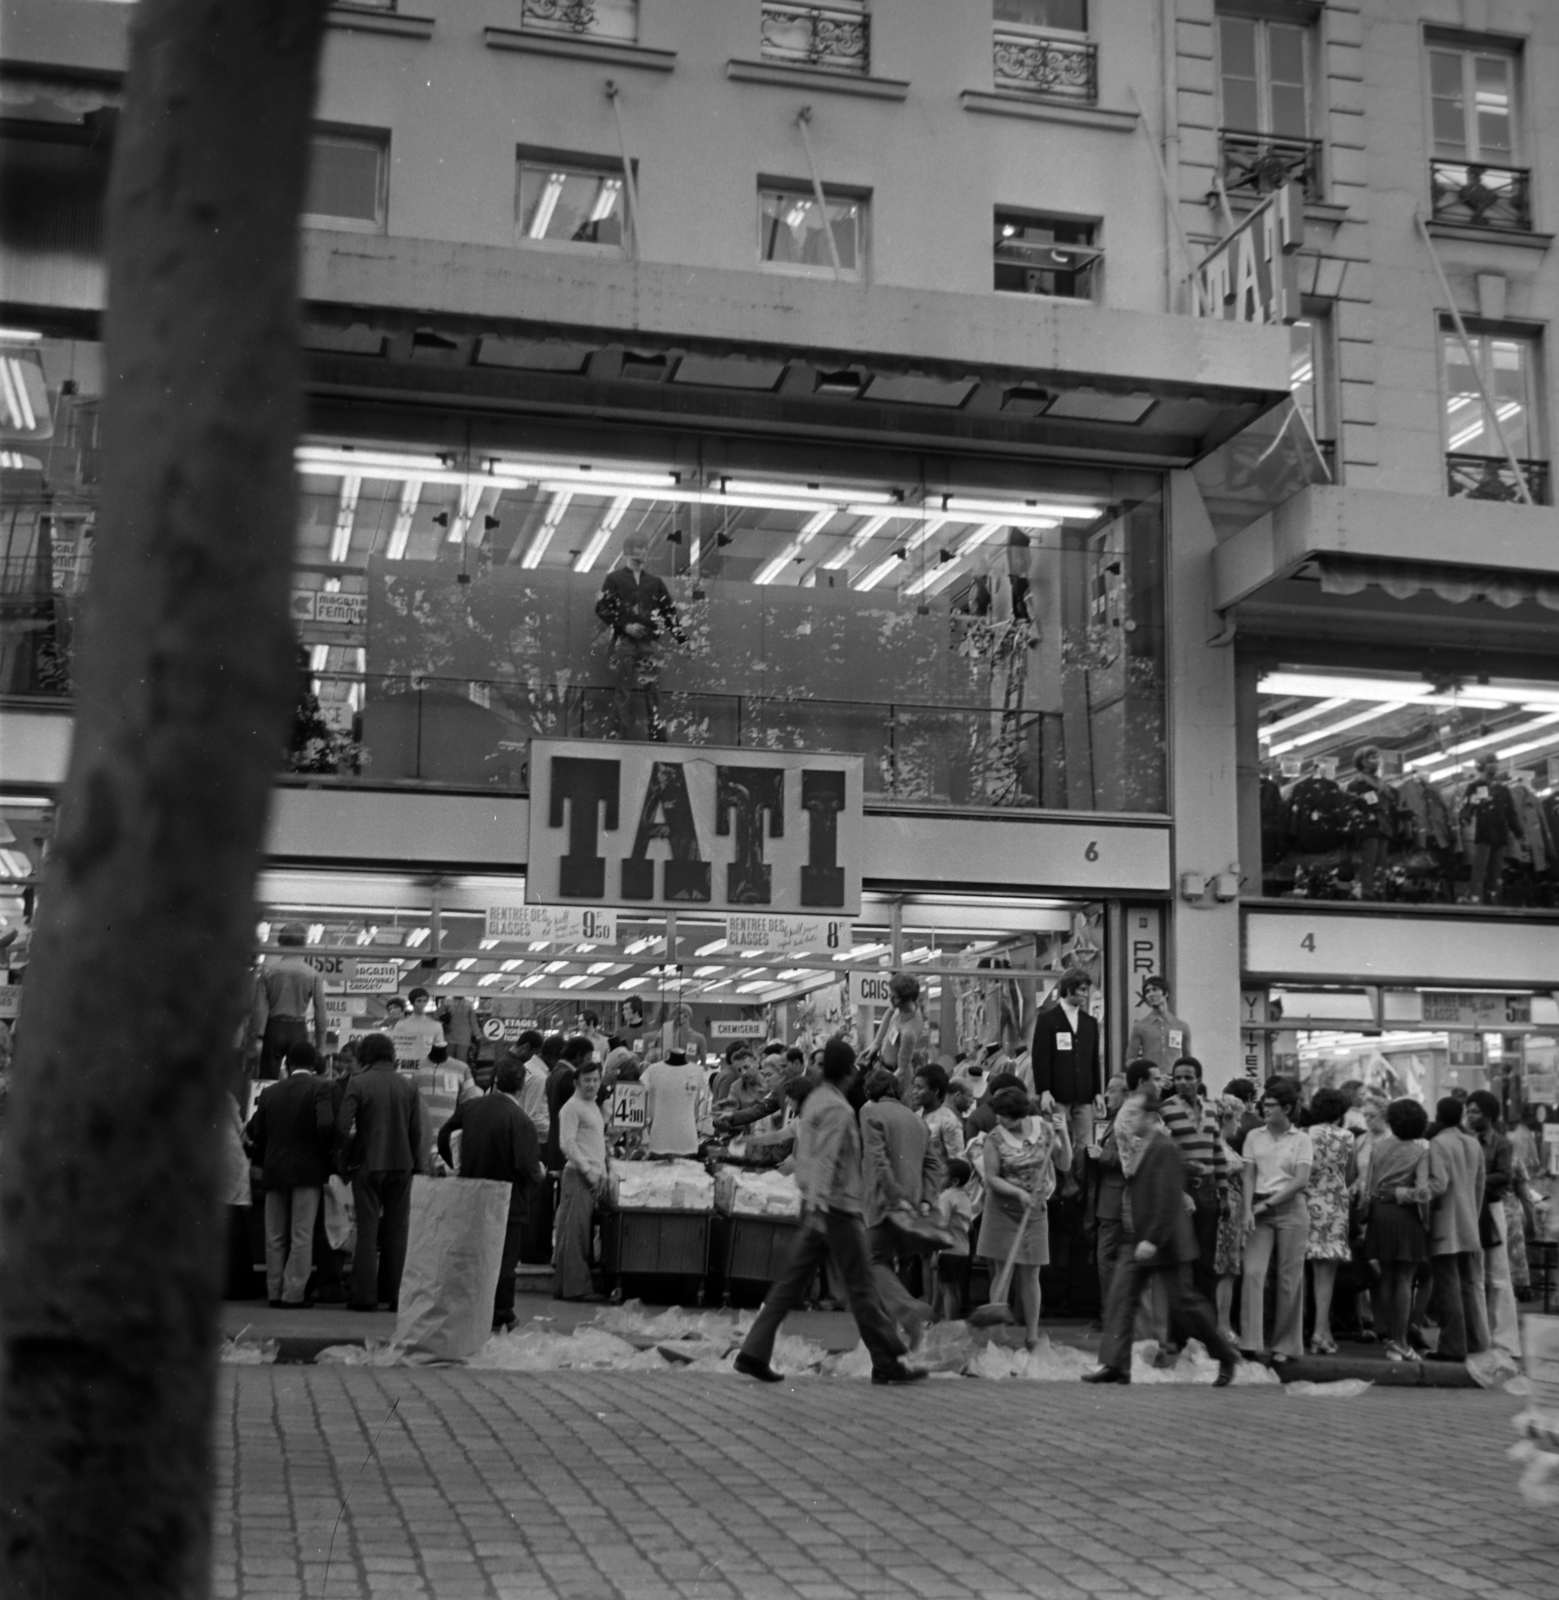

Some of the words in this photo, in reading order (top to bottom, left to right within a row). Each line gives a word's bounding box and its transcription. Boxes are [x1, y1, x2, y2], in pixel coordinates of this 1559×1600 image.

[319, 605, 365, 619] FEMM
[550, 756, 846, 907] TATI
[1084, 841, 1099, 862] 6
[490, 906, 529, 922] RENTREE
[531, 908, 549, 923] DES
[489, 921, 531, 937] CLASSES
[729, 917, 767, 932] RENTREE
[769, 919, 785, 933] DES
[729, 931, 769, 946] CLASSES
[1300, 932, 1317, 953] 4
[861, 978, 891, 1000] CAIS
[325, 1001, 347, 1012] ULLS
[489, 1020, 500, 1037] 2
[718, 1024, 760, 1034] CHEMISERIE
